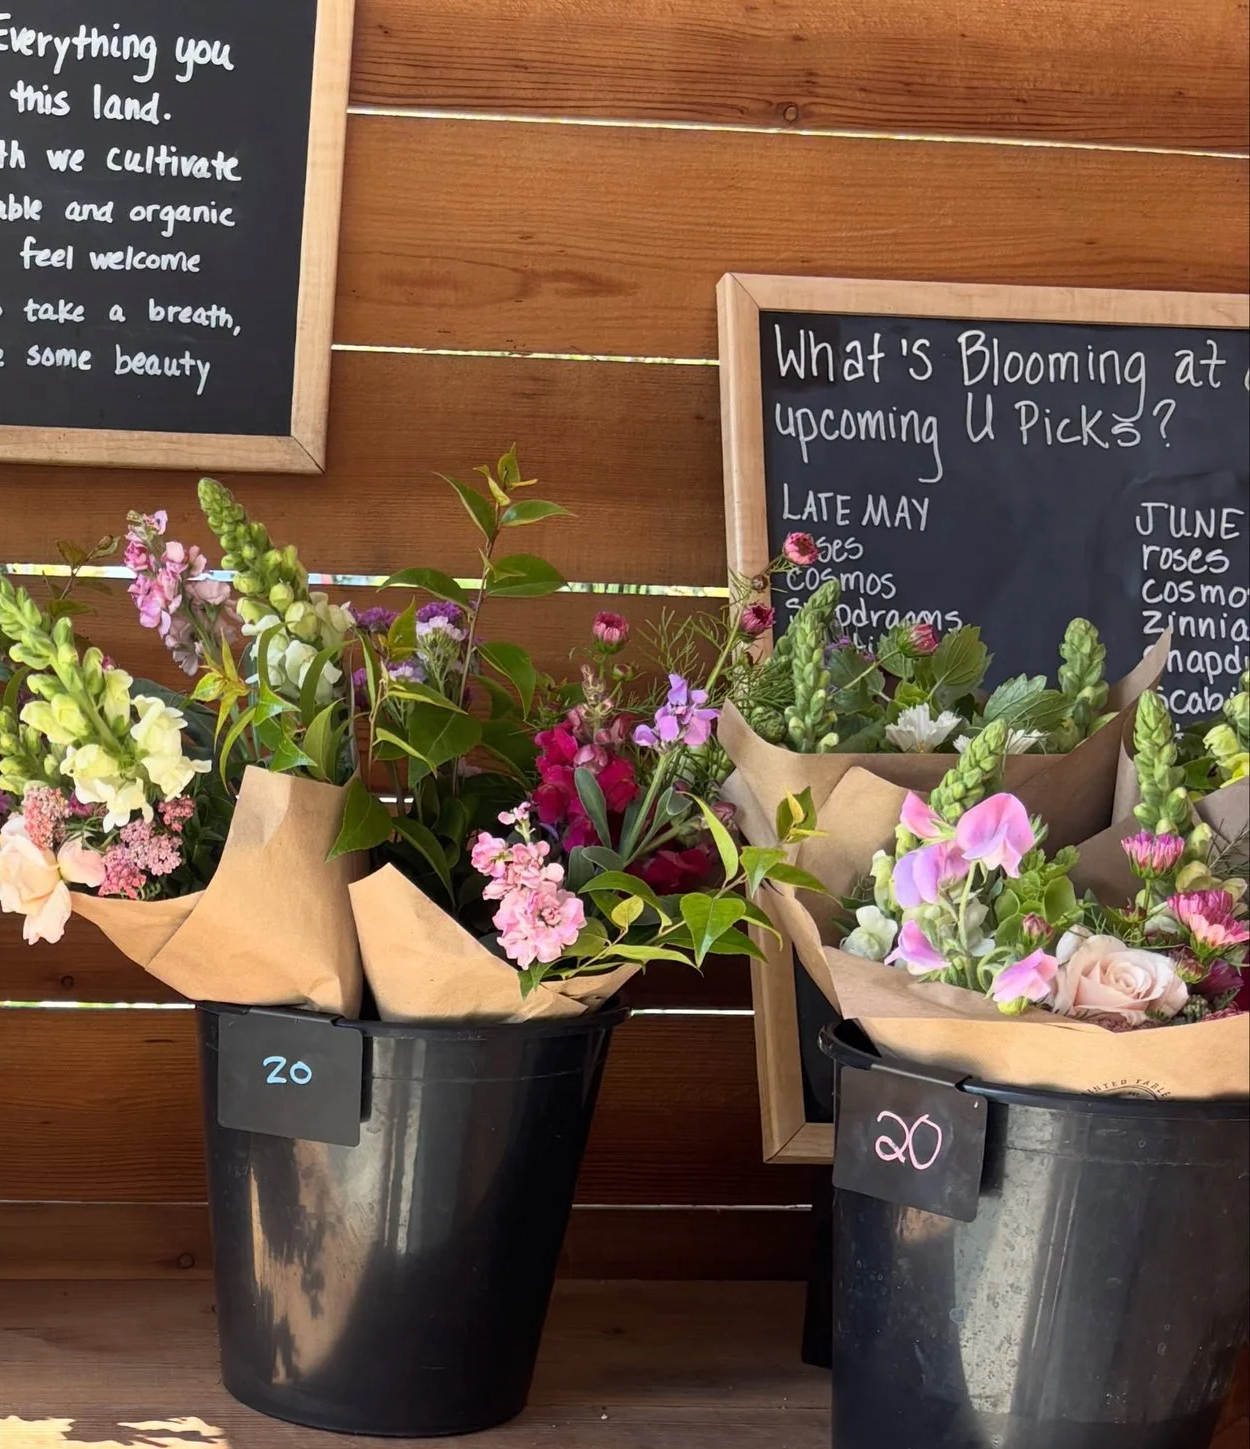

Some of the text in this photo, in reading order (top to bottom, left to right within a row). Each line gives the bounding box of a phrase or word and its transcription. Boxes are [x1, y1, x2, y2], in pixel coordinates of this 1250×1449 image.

[175, 36, 235, 83] you
[9, 79, 71, 116] this
[93, 83, 172, 126] land.
[45, 148, 85, 173] we
[106, 144, 242, 182] cultivate
[64, 200, 114, 224] and
[129, 200, 236, 238] organic
[19, 235, 74, 270] feel
[89, 245, 201, 273] welcome
[23, 298, 85, 324] take
[108, 304, 126, 323] a
[148, 297, 241, 337] breath,
[26, 344, 92, 371] some
[114, 343, 211, 396] beauty
[773, 323, 934, 385] What's
[956, 329, 1147, 422] Blooming
[1175, 339, 1227, 389] at
[774, 403, 944, 484] upcoming
[965, 391, 996, 443] U
[782, 482, 931, 532] LATE MAY
[1135, 501, 1246, 540] JUNE
[1141, 543, 1231, 574] roses
[1141, 578, 1250, 608] cosmo
[1142, 644, 1250, 685] napd
[262, 1055, 313, 1085] 20
[875, 1110, 943, 1170] 20
